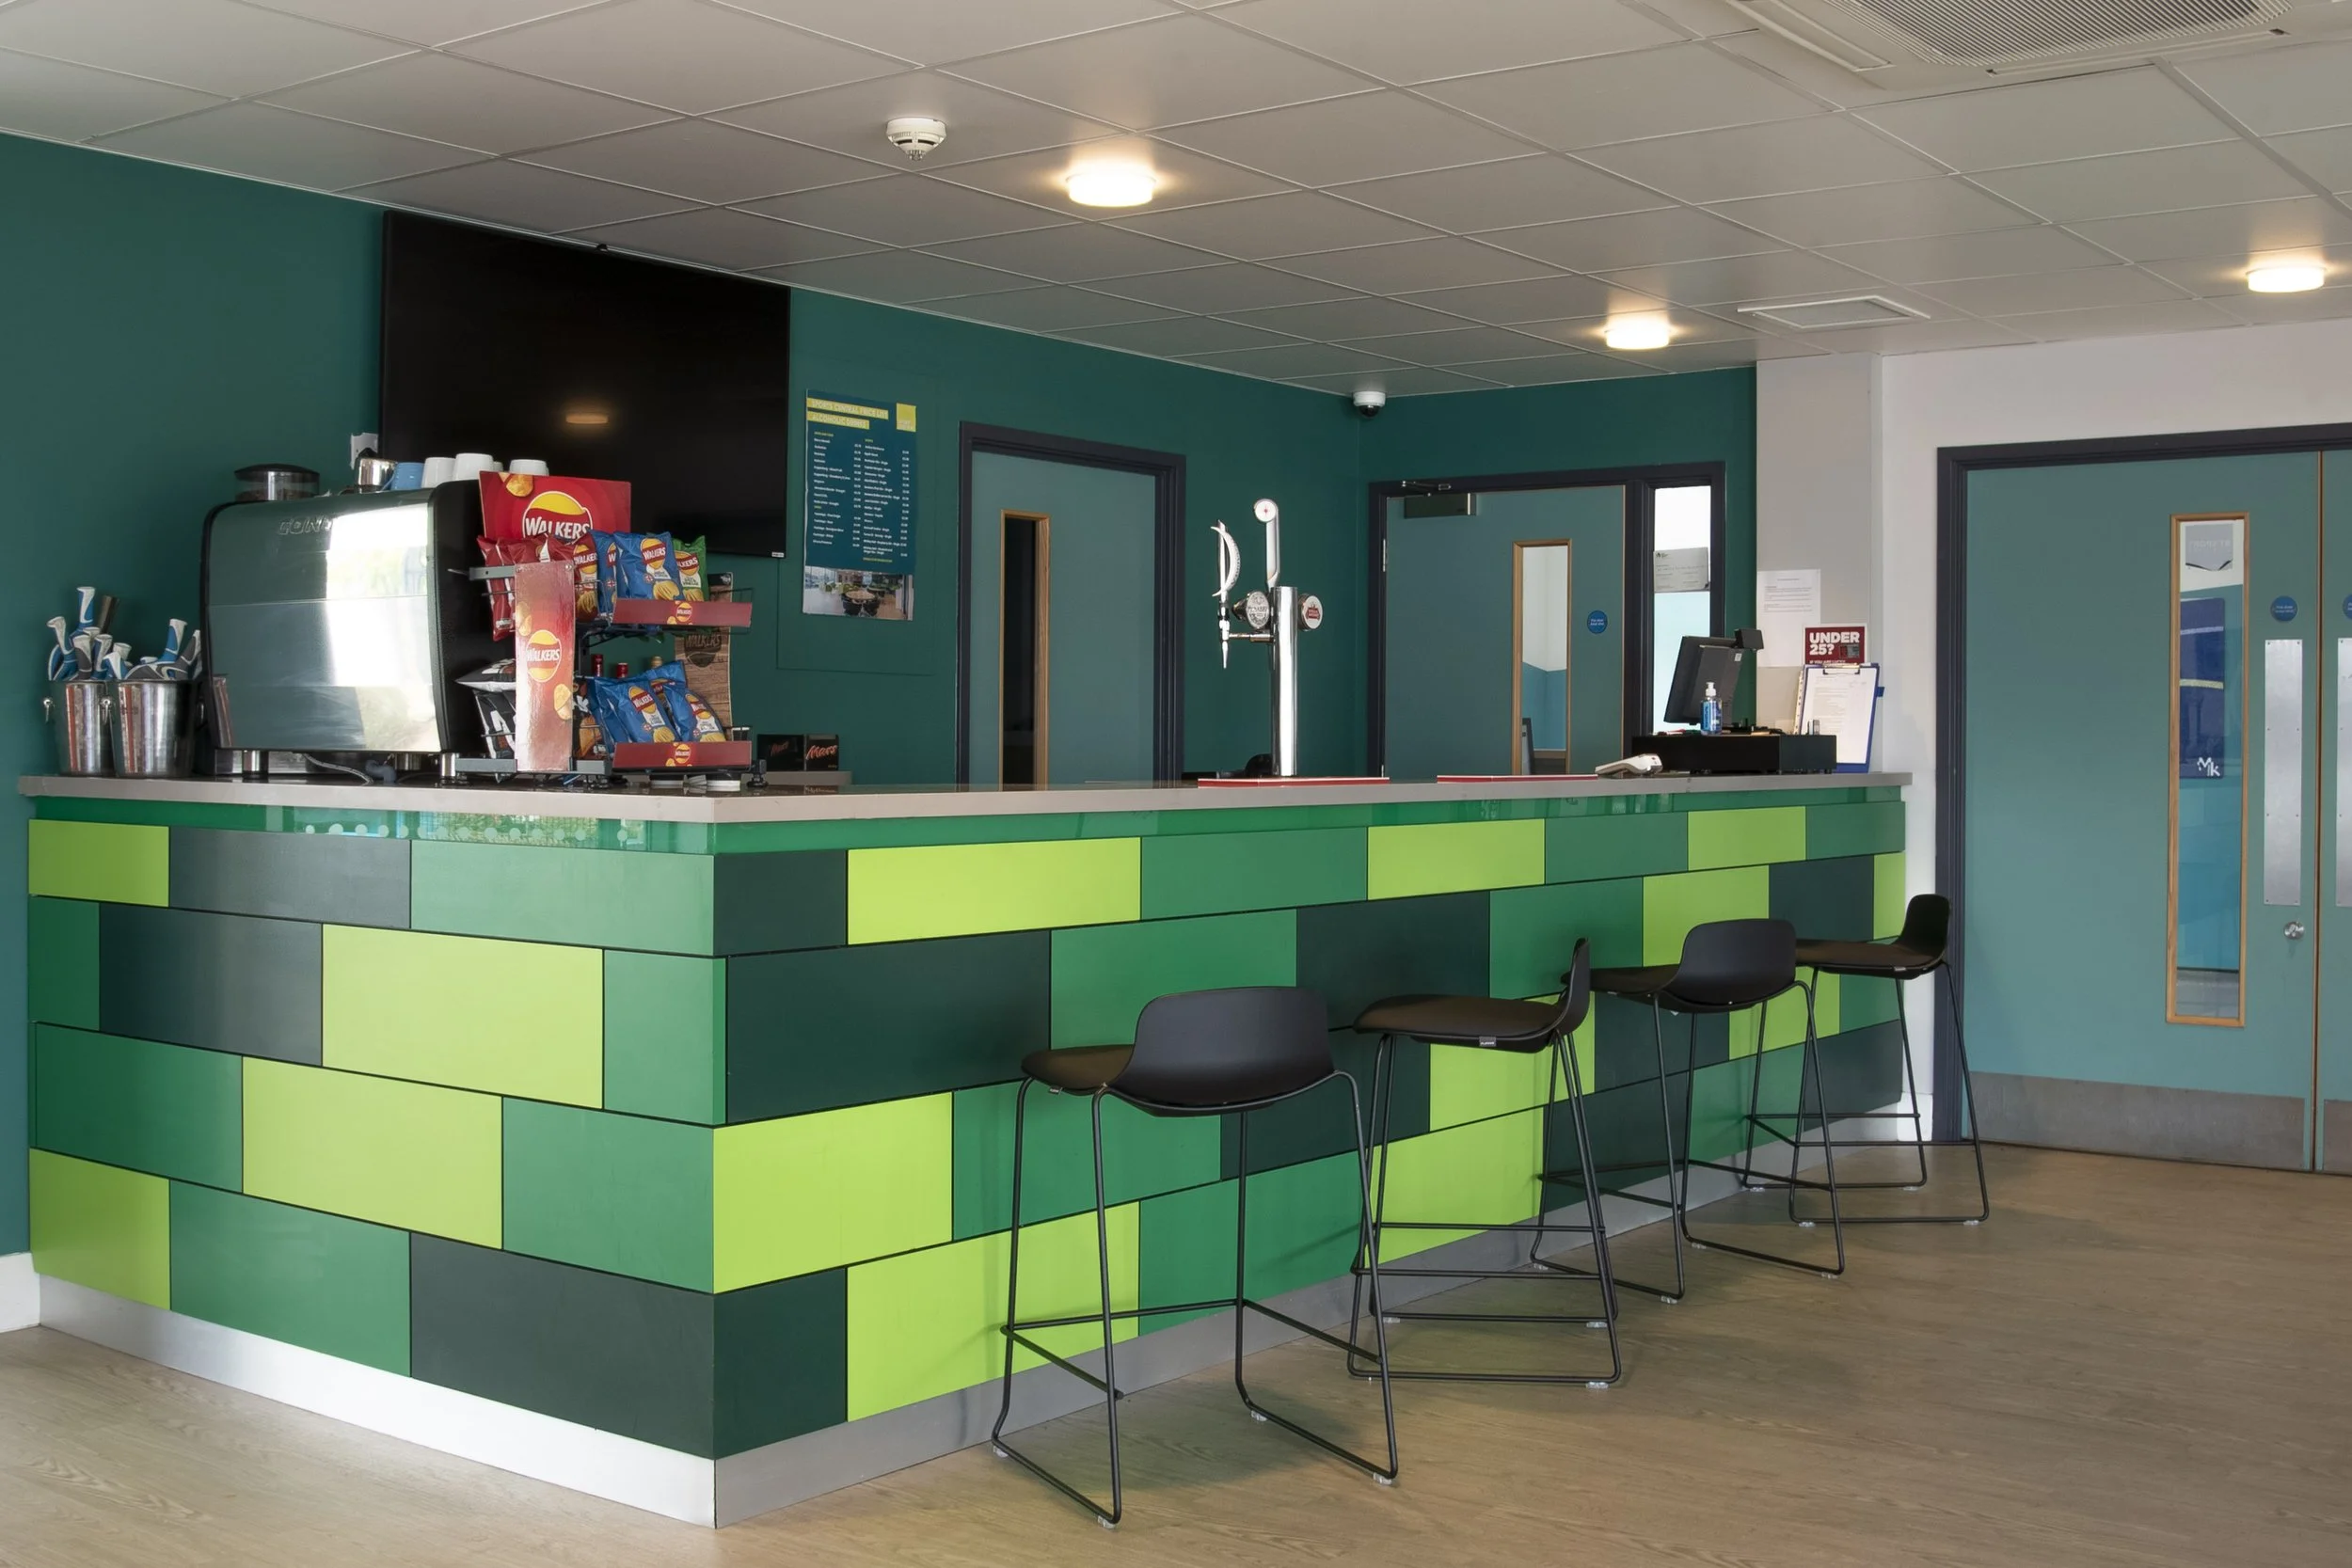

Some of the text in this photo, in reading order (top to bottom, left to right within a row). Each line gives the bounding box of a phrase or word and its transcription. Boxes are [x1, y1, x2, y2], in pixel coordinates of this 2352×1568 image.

[812, 400, 833, 411] SPORTS
[834, 403, 860, 416] CENTRAL
[812, 414, 846, 426] ALCOHOLIC
[643, 546, 666, 562] WALKERS
[1809, 631, 1860, 643] UNDER
[527, 648, 560, 661] WALKERS
[1809, 643, 1835, 656] 25?
[805, 744, 837, 760] Mars
